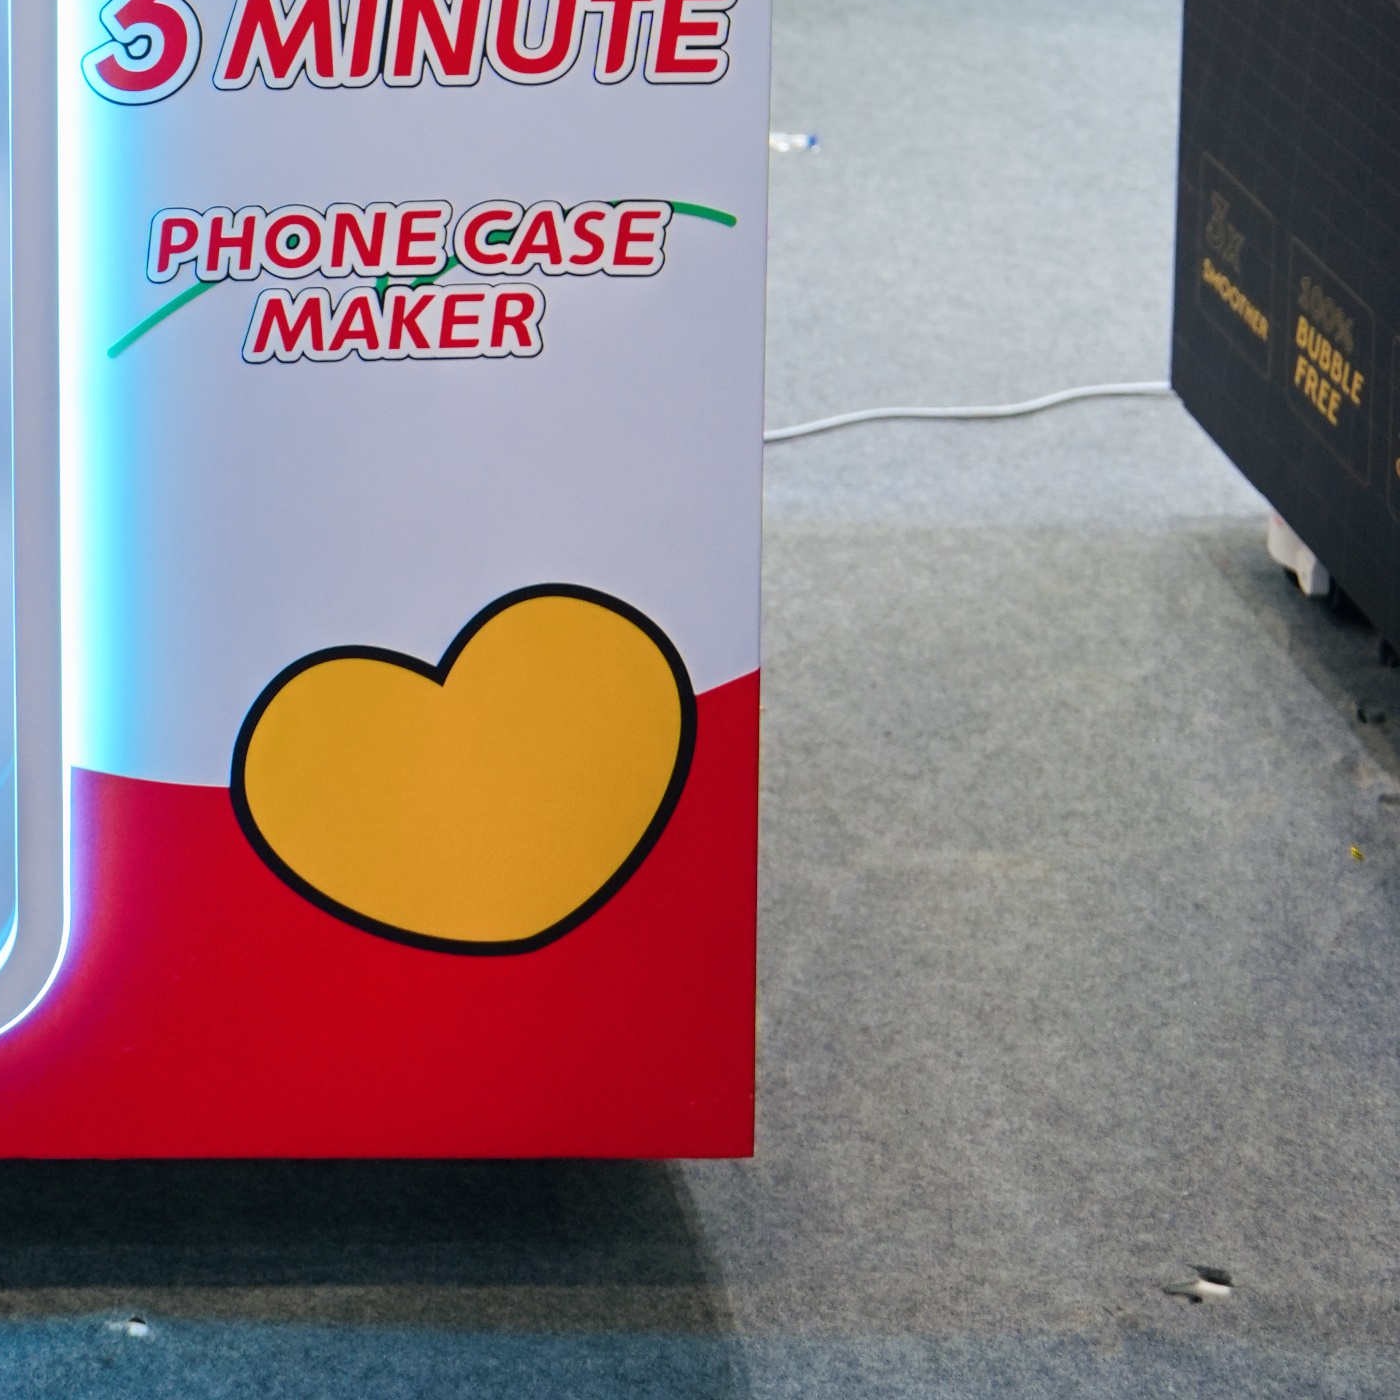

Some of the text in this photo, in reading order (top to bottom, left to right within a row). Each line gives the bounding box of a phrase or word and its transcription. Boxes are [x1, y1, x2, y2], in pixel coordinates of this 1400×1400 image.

[152, 204, 667, 278] PHONE CASE
[247, 287, 539, 358] MAKER
[1294, 353, 1342, 427] FREE
[1295, 314, 1365, 407] BUBBLE
